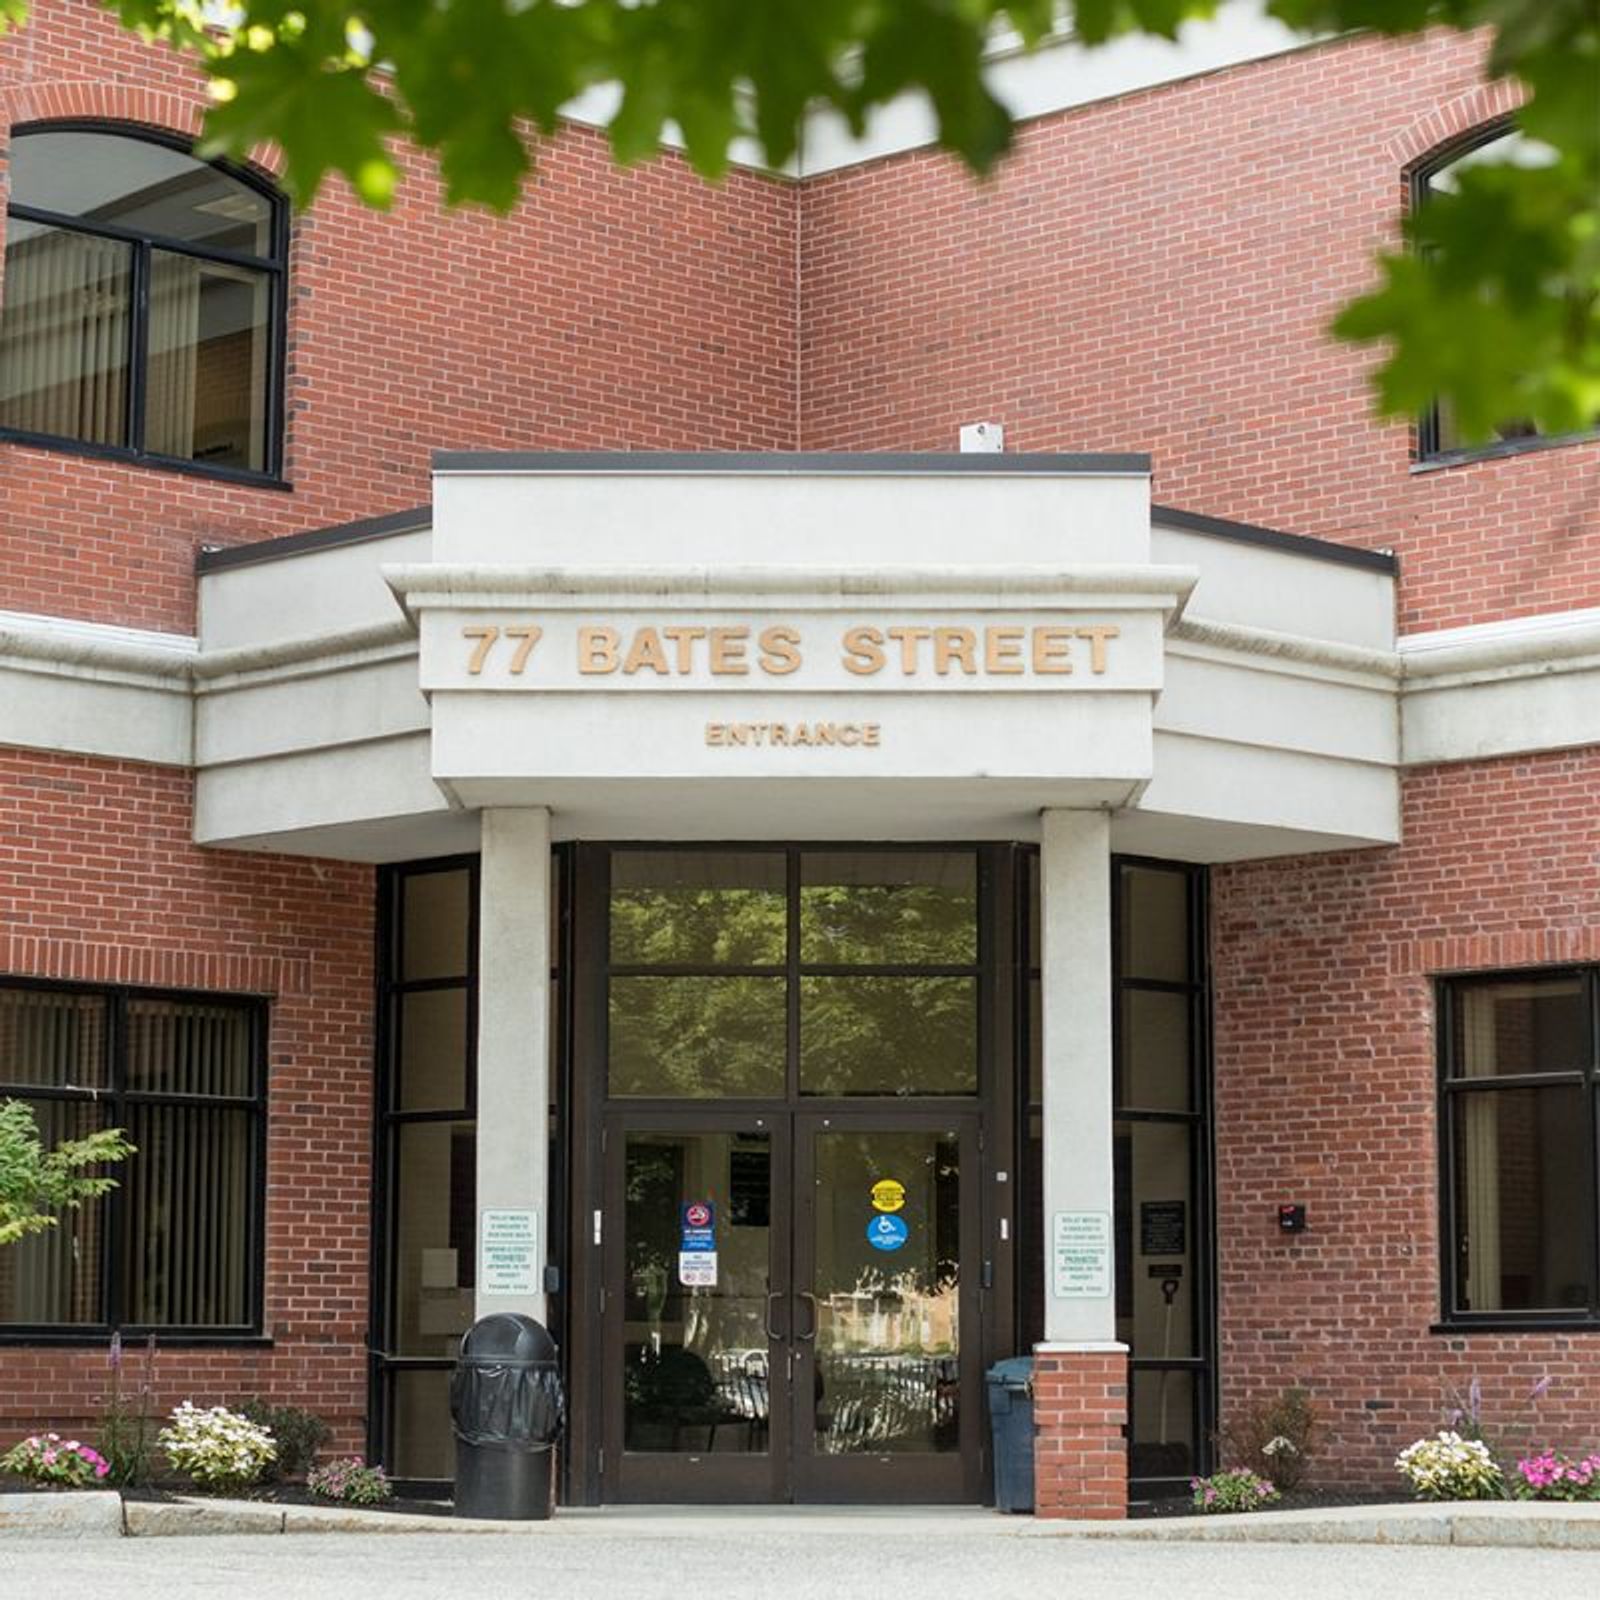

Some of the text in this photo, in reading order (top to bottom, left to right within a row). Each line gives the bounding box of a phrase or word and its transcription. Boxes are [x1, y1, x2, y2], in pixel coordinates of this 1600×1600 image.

[462, 626, 1121, 675] 77 BATES STREET
[705, 722, 880, 747] ENTRANCE
